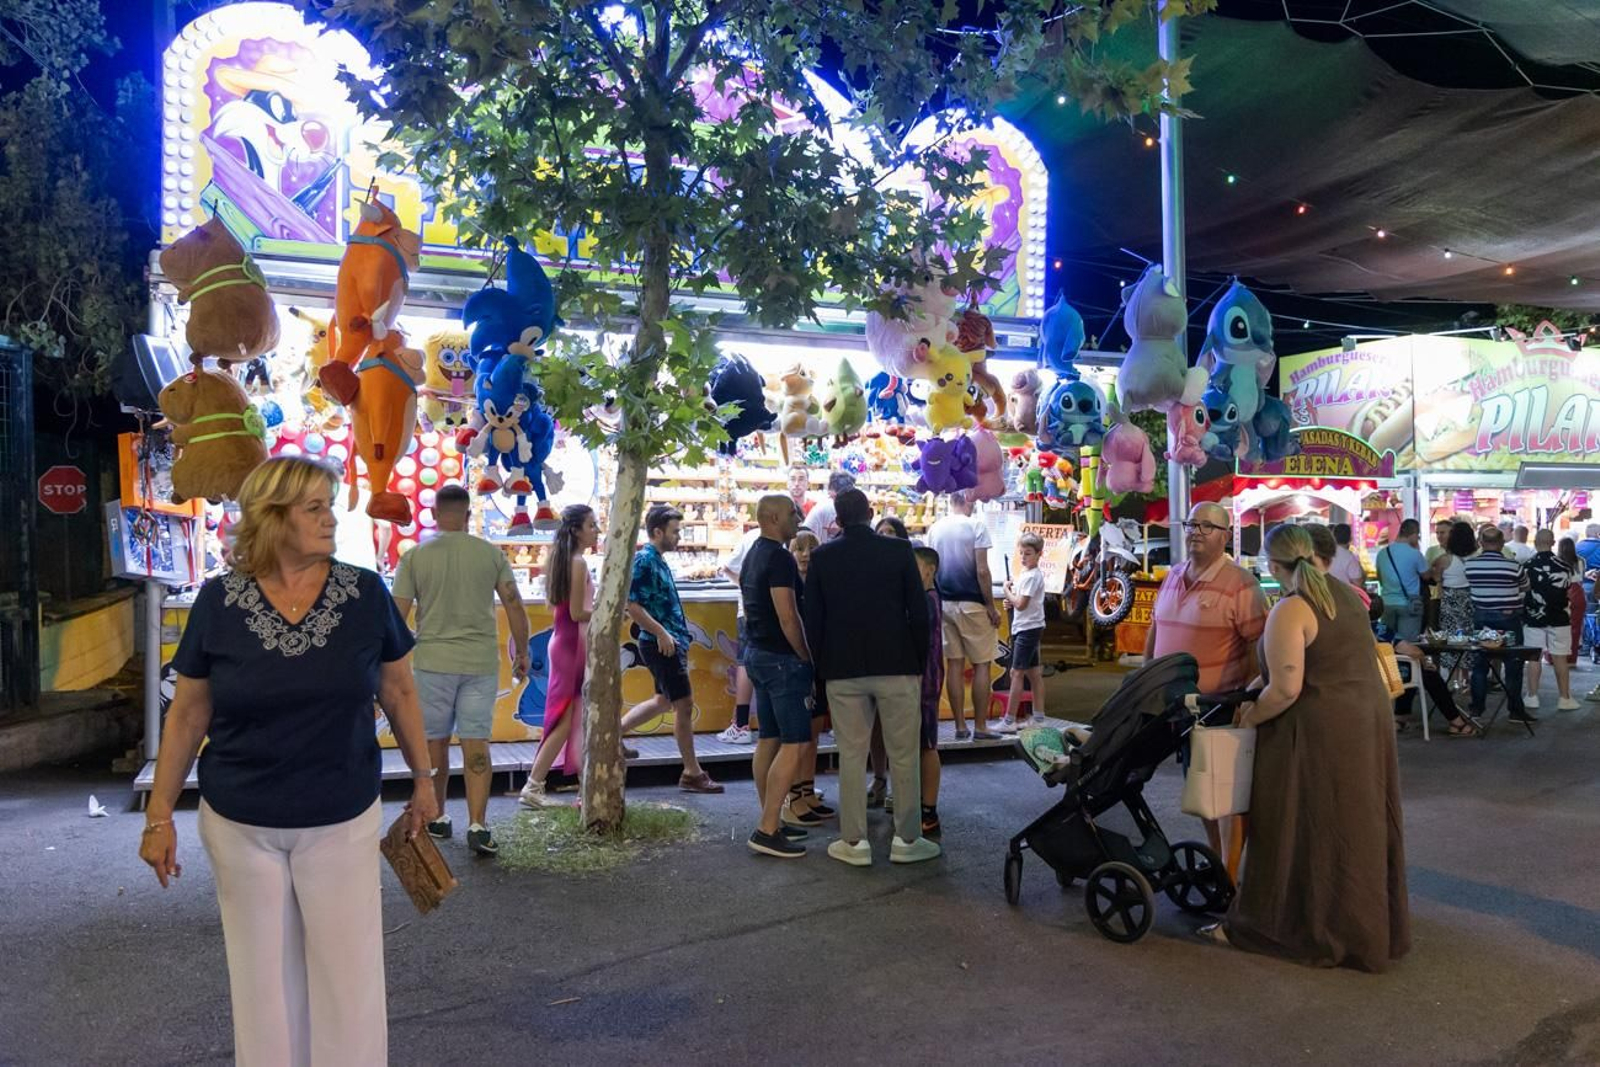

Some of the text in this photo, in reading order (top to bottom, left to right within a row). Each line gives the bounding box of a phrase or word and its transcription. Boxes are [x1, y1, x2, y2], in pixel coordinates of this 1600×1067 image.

[1289, 350, 1397, 384] Hamburgueser
[1283, 454, 1355, 476] ELENA
[43, 484, 87, 496] STOP
[1023, 525, 1069, 539] OFERTA
